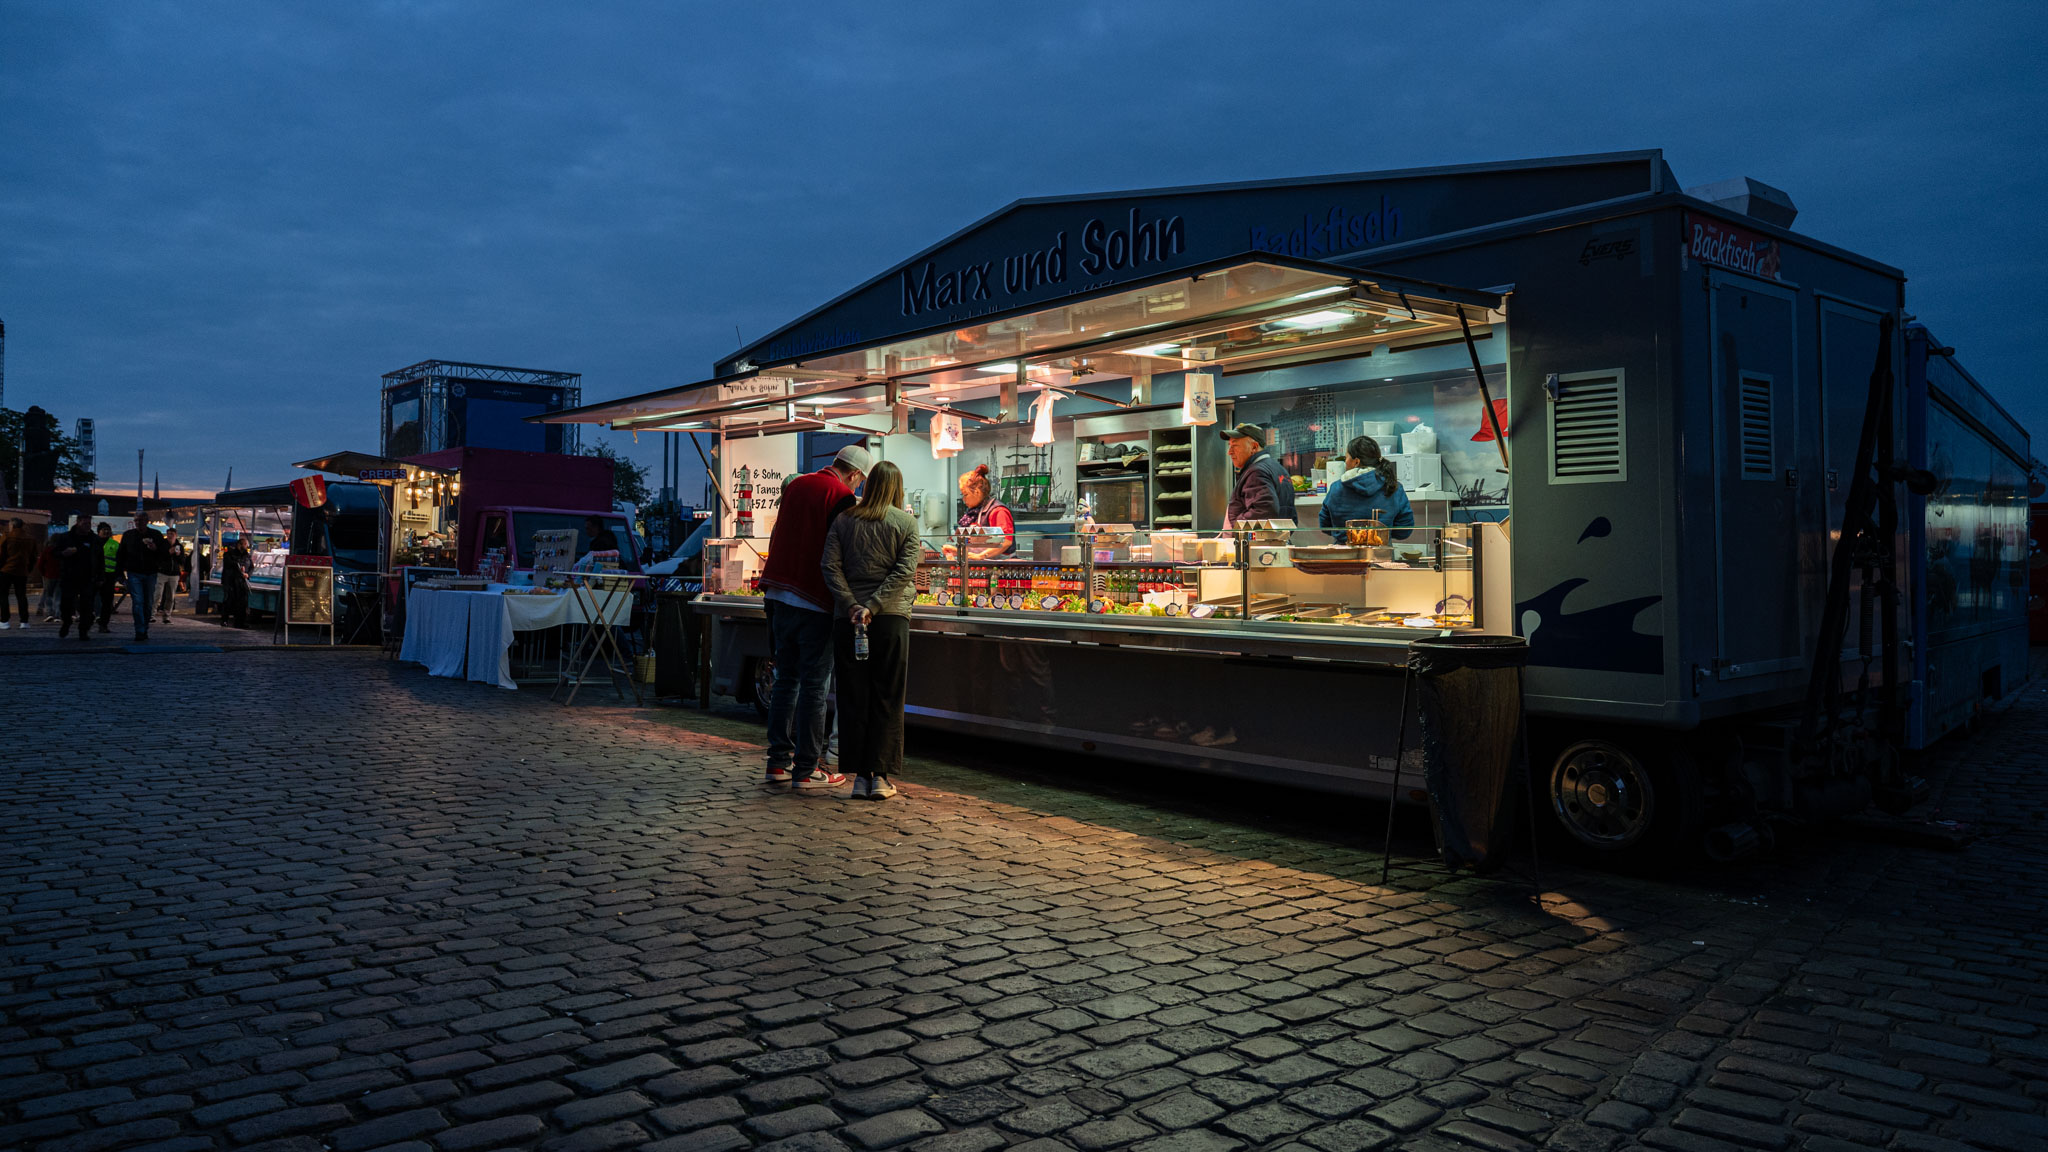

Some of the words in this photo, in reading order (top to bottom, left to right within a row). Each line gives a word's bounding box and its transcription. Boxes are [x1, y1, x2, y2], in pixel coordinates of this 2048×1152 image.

[1249, 193, 1404, 258] Backfisch
[901, 262, 994, 316] Marx
[1003, 230, 1067, 294] und
[1080, 207, 1186, 276] Sohn
[360, 469, 407, 479] CREPES
[753, 468, 760, 479] &
[762, 468, 783, 480] Sohn,
